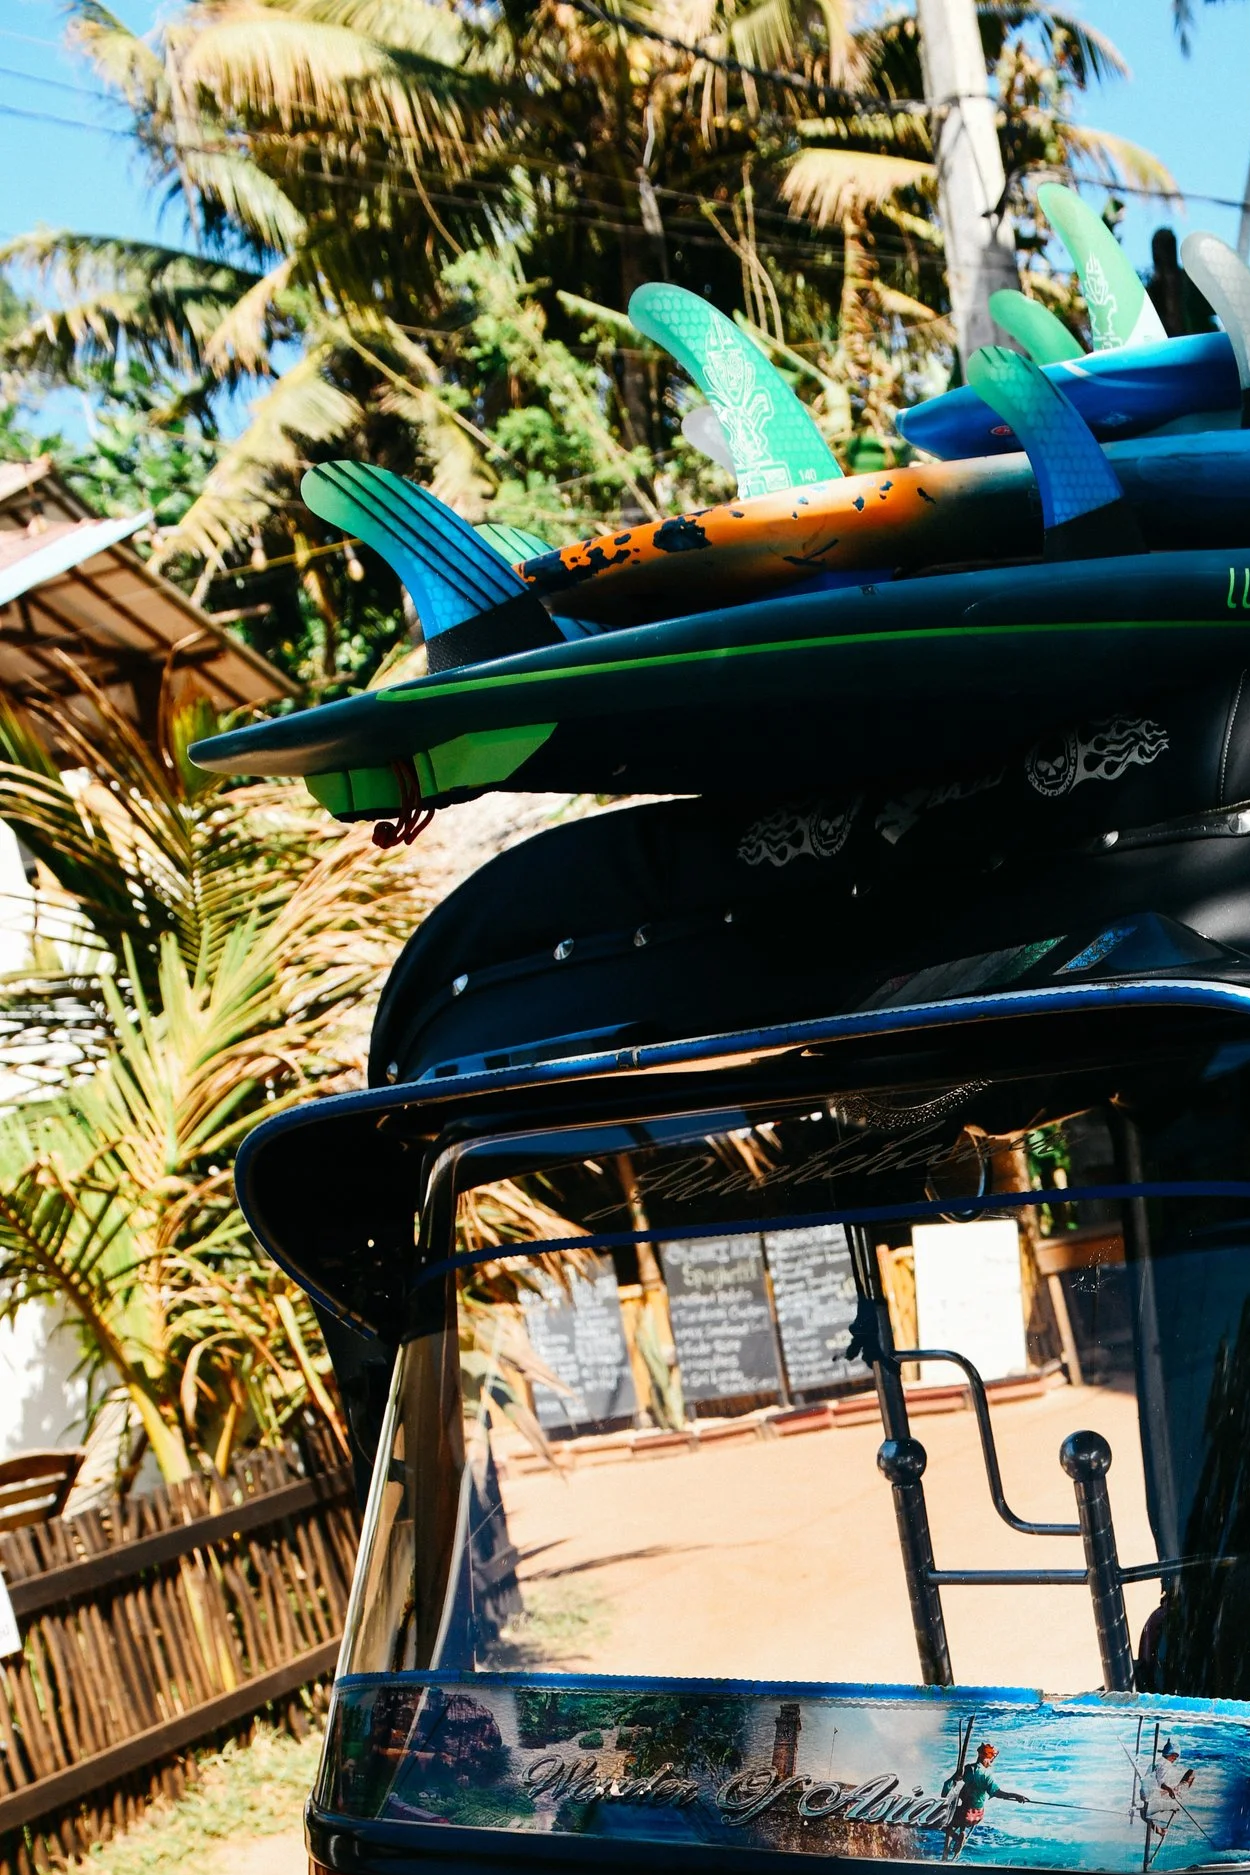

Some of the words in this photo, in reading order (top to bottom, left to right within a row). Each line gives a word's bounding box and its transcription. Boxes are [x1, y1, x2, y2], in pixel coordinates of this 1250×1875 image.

[522, 1754, 700, 1806] Wonder
[716, 1767, 811, 1827] Of
[798, 1773, 957, 1827] Asia
